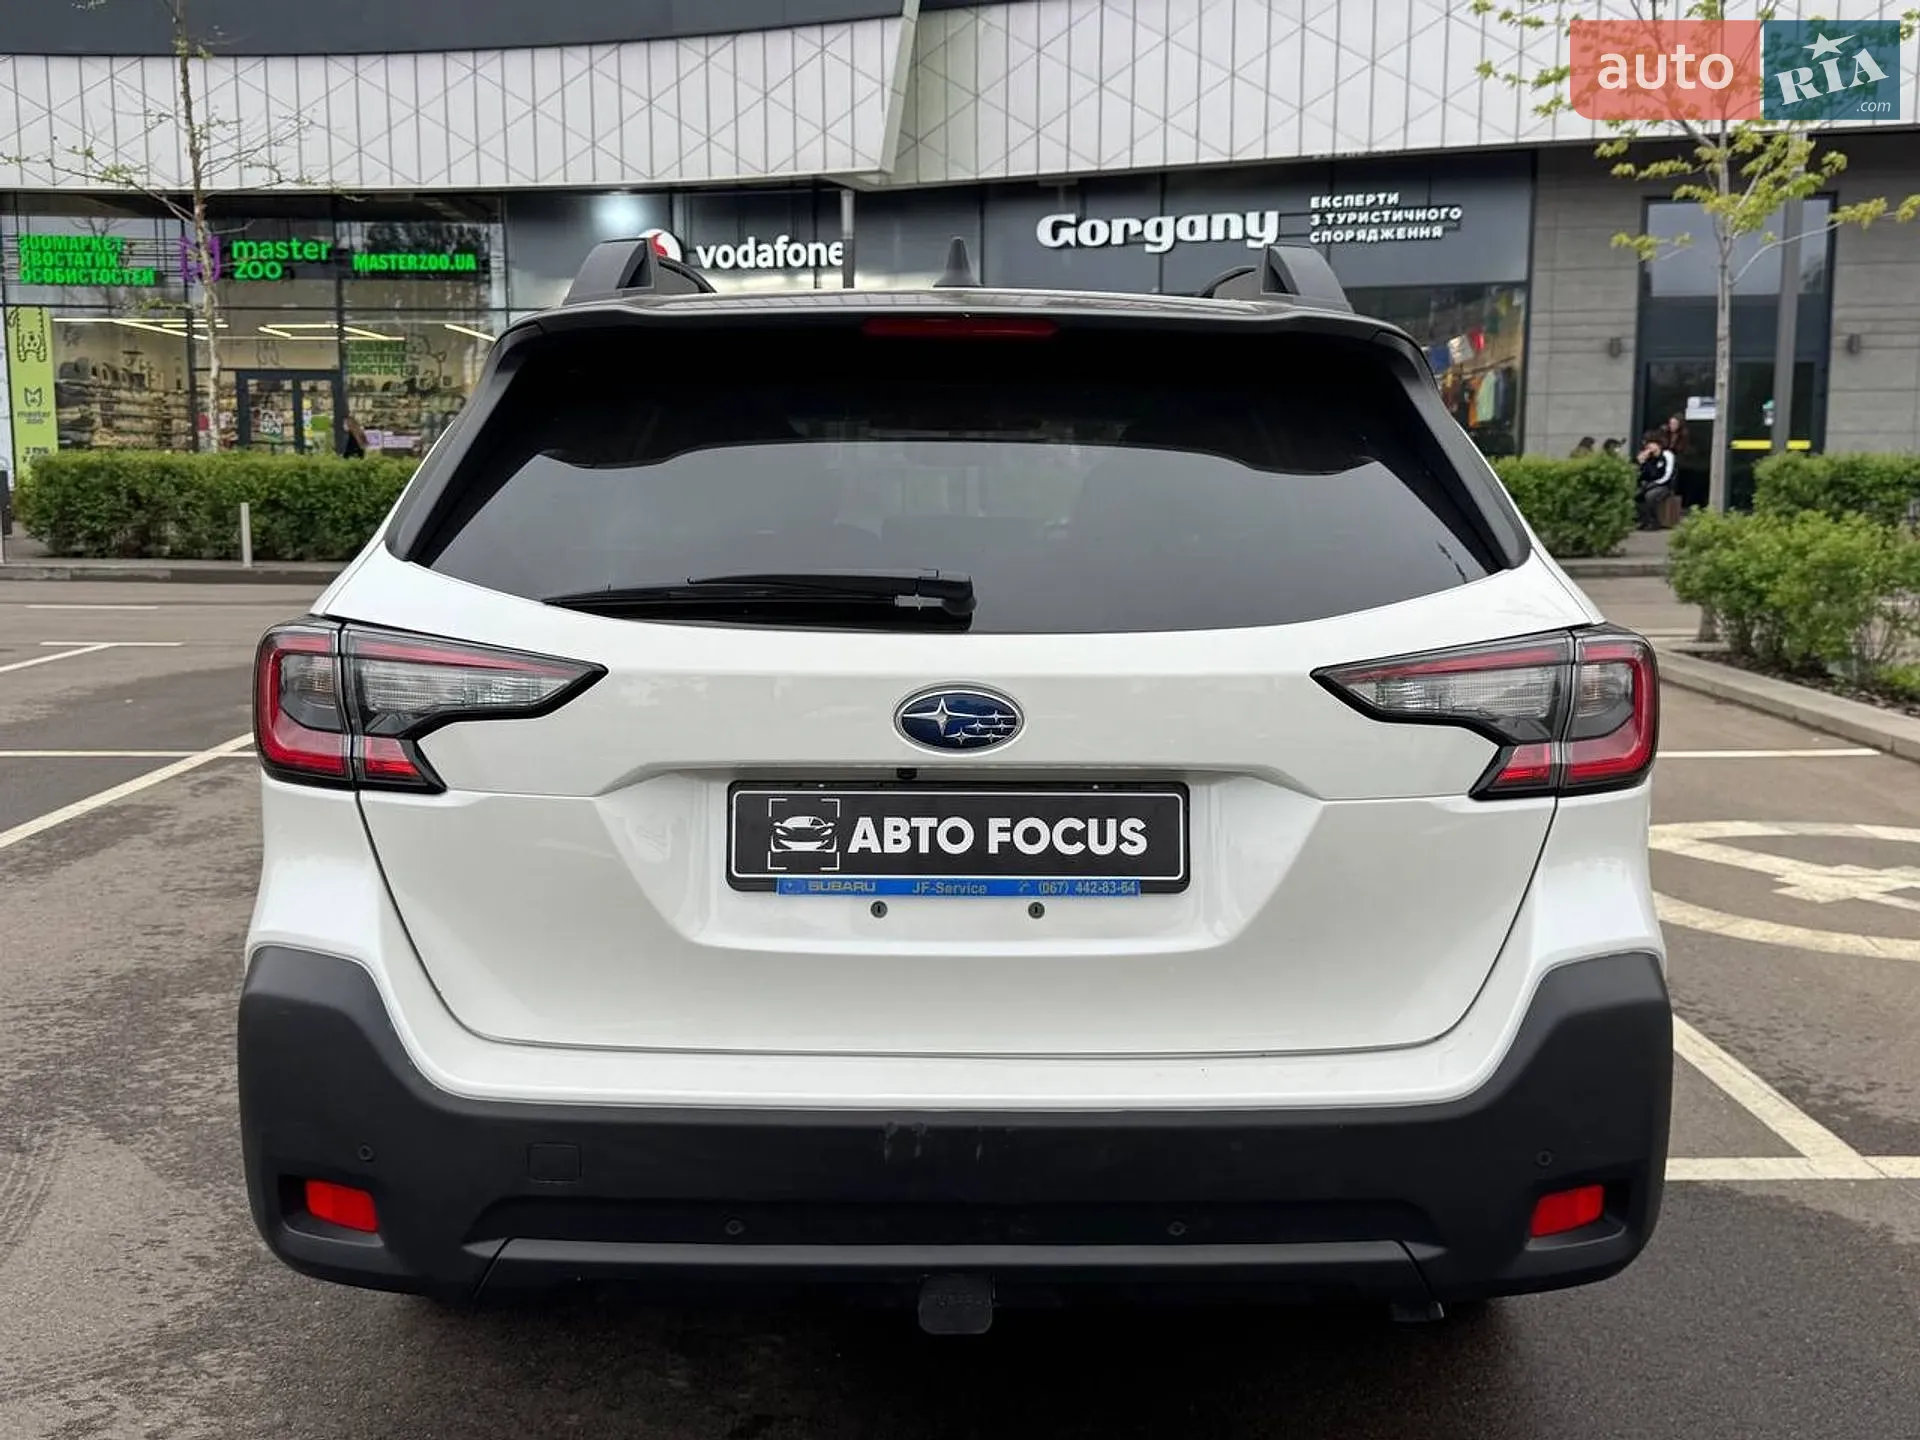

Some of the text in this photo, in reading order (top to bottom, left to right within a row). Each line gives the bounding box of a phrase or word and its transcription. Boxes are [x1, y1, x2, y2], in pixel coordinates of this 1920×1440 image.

[1310, 192, 1399, 208] ЕКСПЕРТИ
[1325, 207, 1463, 226] ТУРИСТИЧНОГО
[1036, 210, 1280, 253] Gorgany
[1310, 225, 1444, 243] СПОРЯДЖЕННЯ
[231, 237, 332, 261] master
[695, 235, 843, 269] vodafone
[234, 261, 283, 280] zoo
[353, 254, 477, 271] MASTERZOO.UA
[987, 817, 1148, 855] FOCUS
[808, 880, 876, 892] SUBARU
[912, 881, 988, 895] JF-Service
[1038, 881, 1069, 894] (067)
